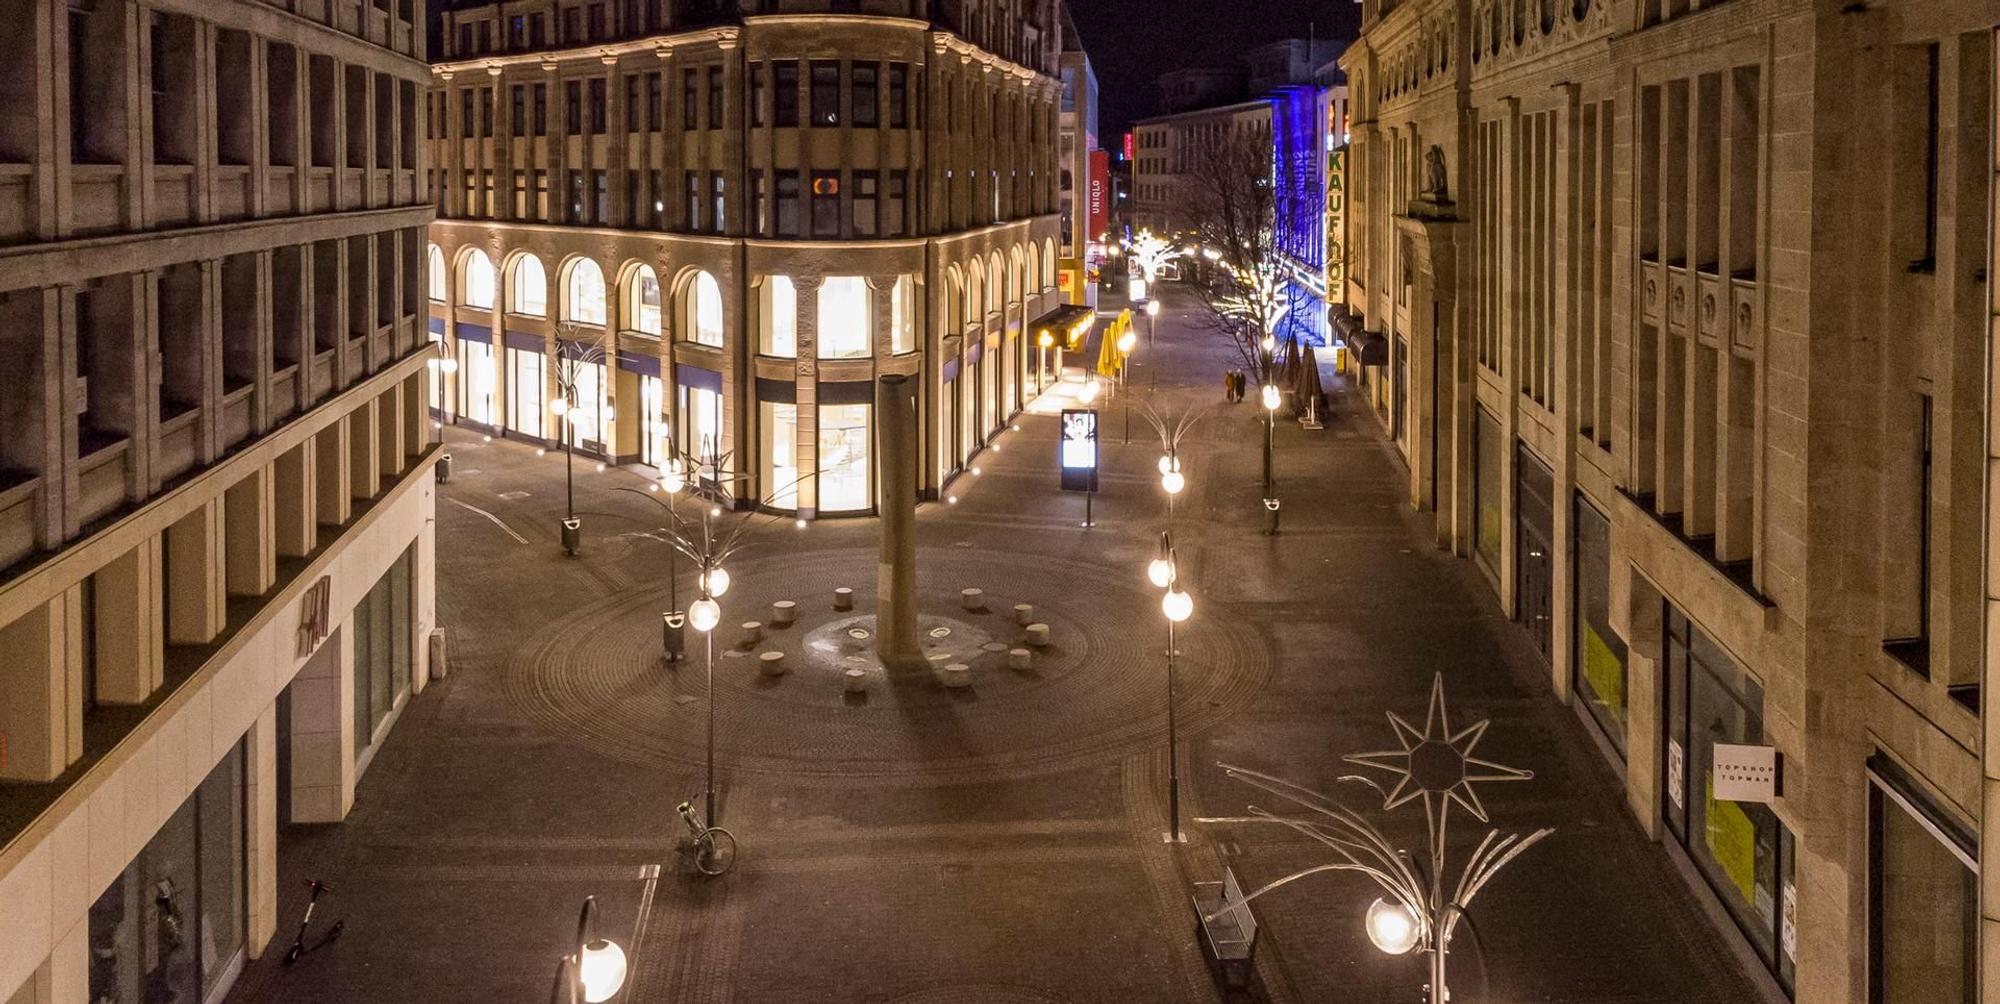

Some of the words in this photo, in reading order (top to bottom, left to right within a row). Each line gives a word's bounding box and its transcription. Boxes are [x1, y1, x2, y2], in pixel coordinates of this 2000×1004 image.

[1092, 180, 1100, 214] UNIQLO
[1717, 764, 1773, 772] TOPSHOP
[1722, 774, 1769, 783] TOPMAN
